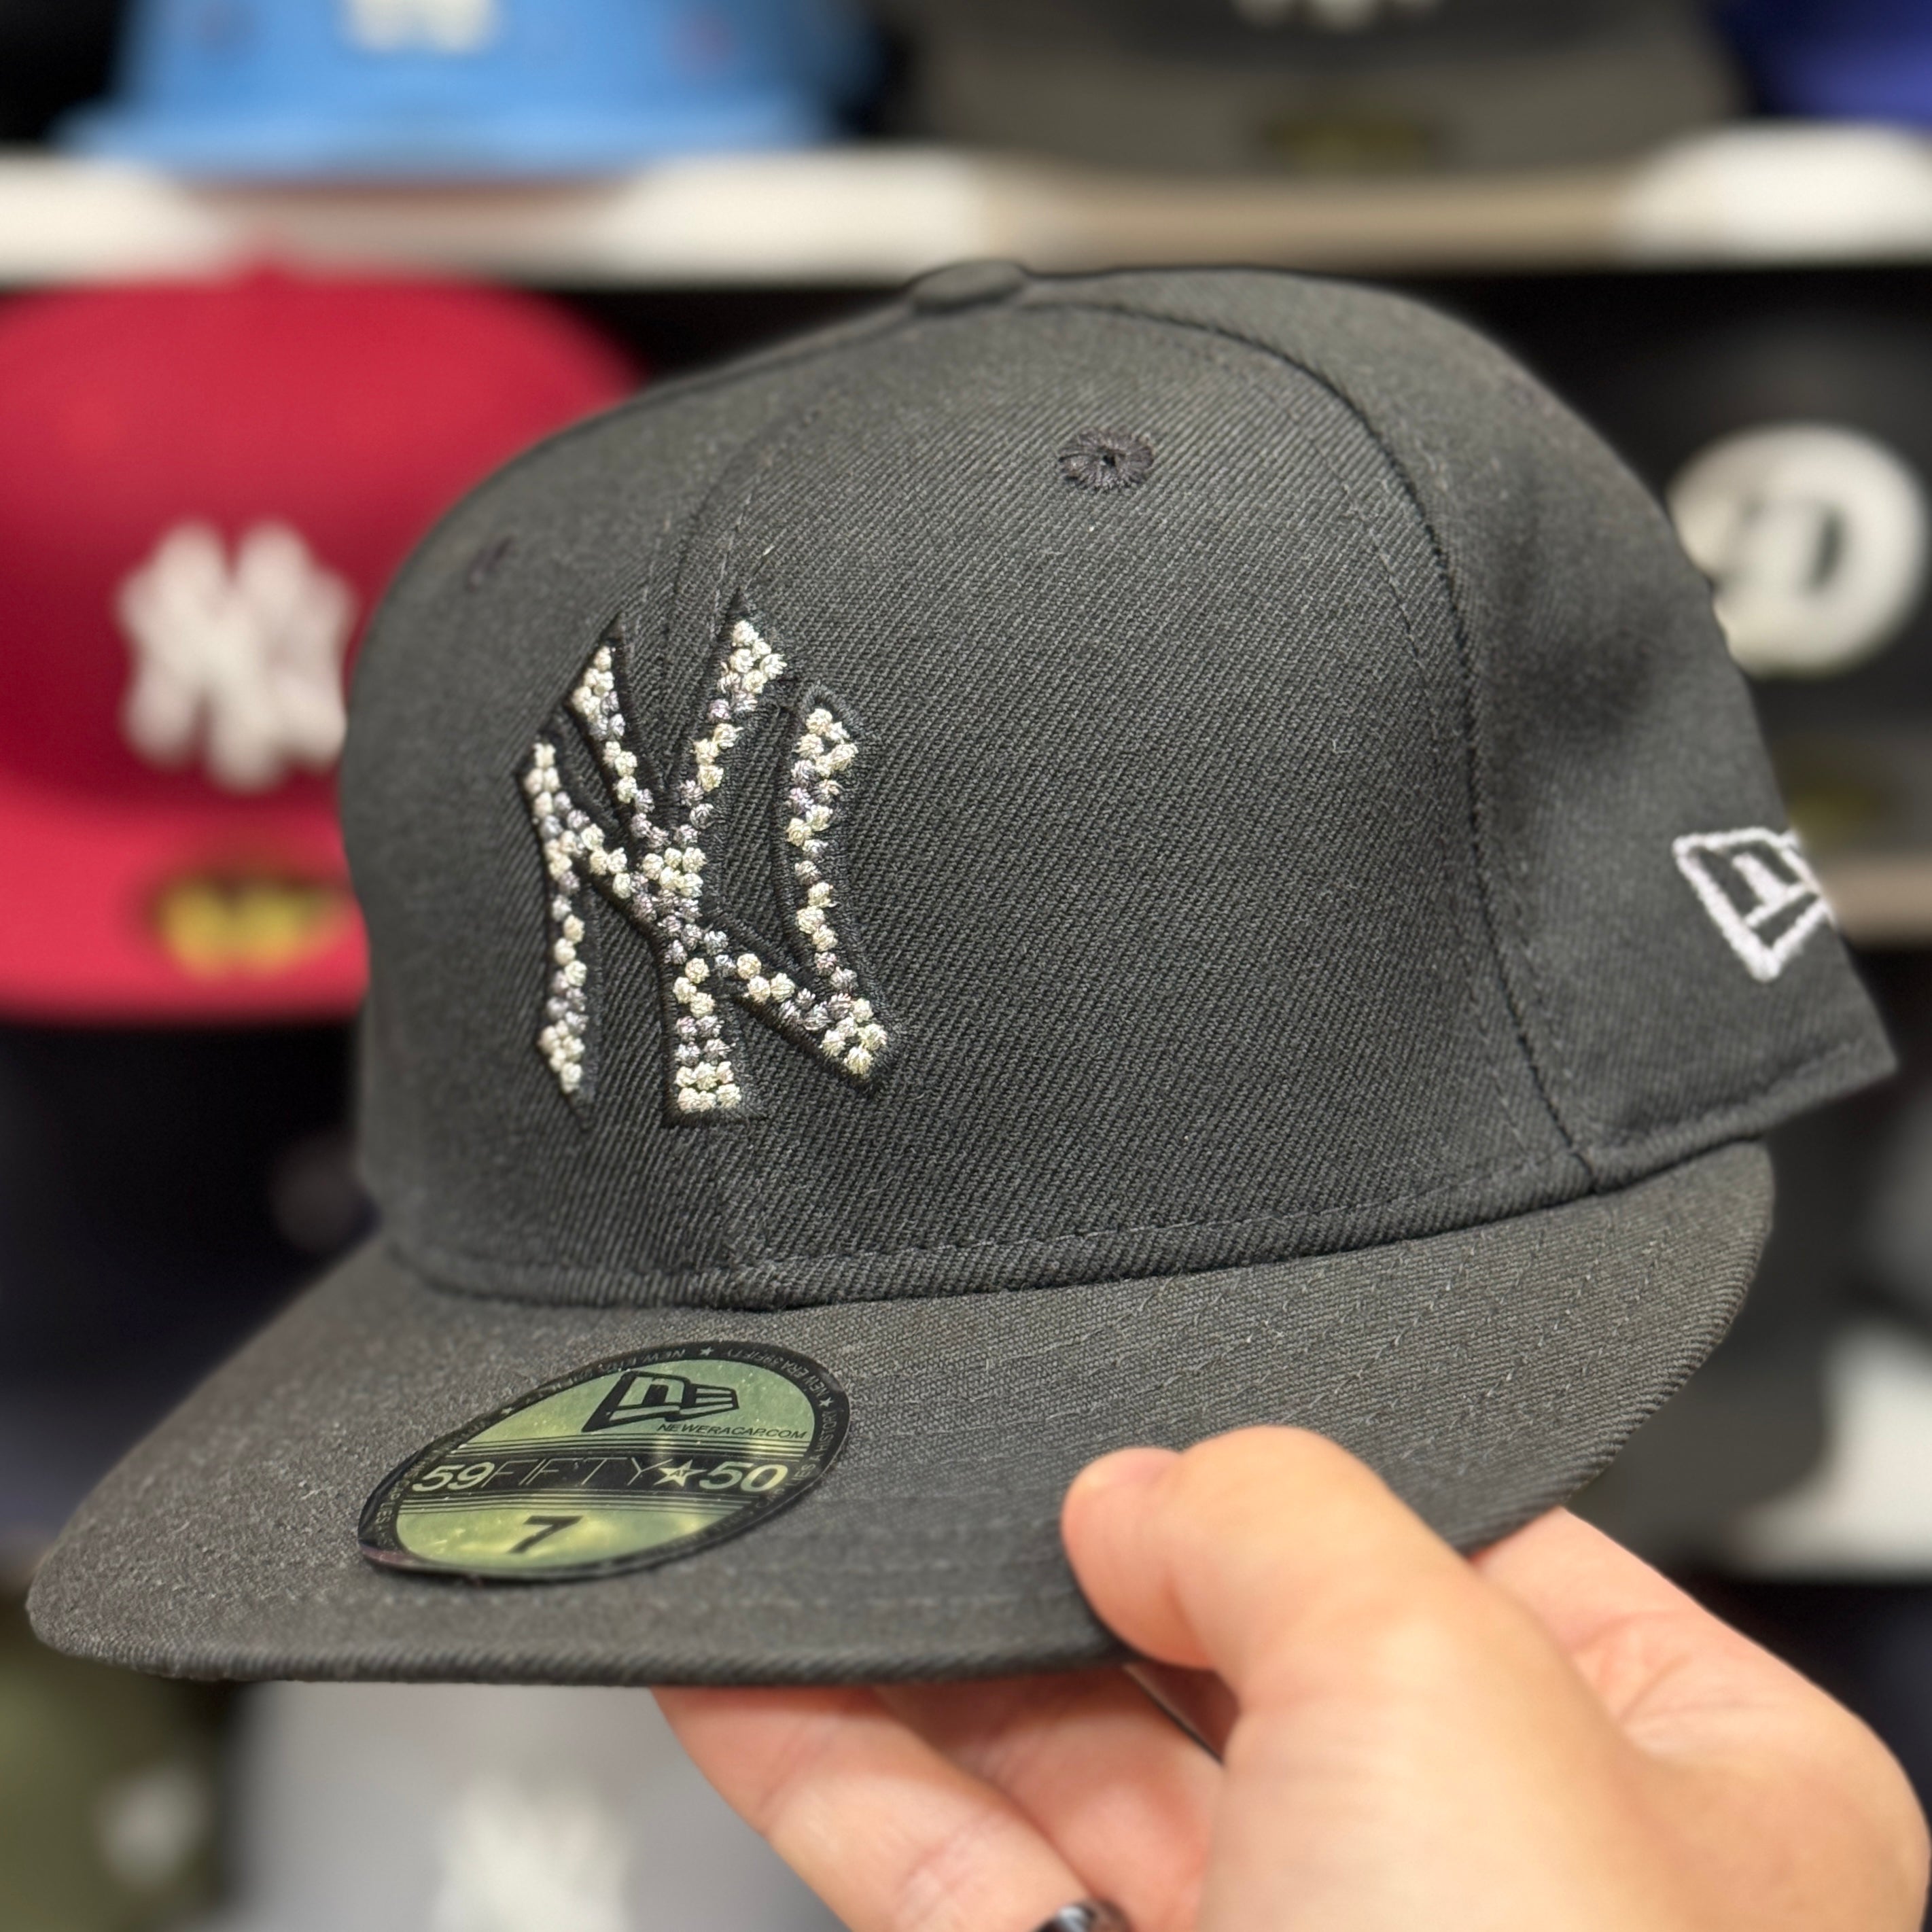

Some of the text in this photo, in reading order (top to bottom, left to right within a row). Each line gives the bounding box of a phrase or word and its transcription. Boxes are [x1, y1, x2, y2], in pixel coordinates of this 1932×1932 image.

[515, 591, 892, 1125] NY
[781, 1360, 809, 1378] ERA
[807, 1373, 830, 1398] NEW
[656, 1424, 808, 1439] NEWERACAP.COM
[816, 1409, 837, 1452] HISTORY
[412, 1457, 674, 1492] 59FIFTY
[699, 1461, 789, 1492] 50
[507, 1515, 584, 1554] 7
